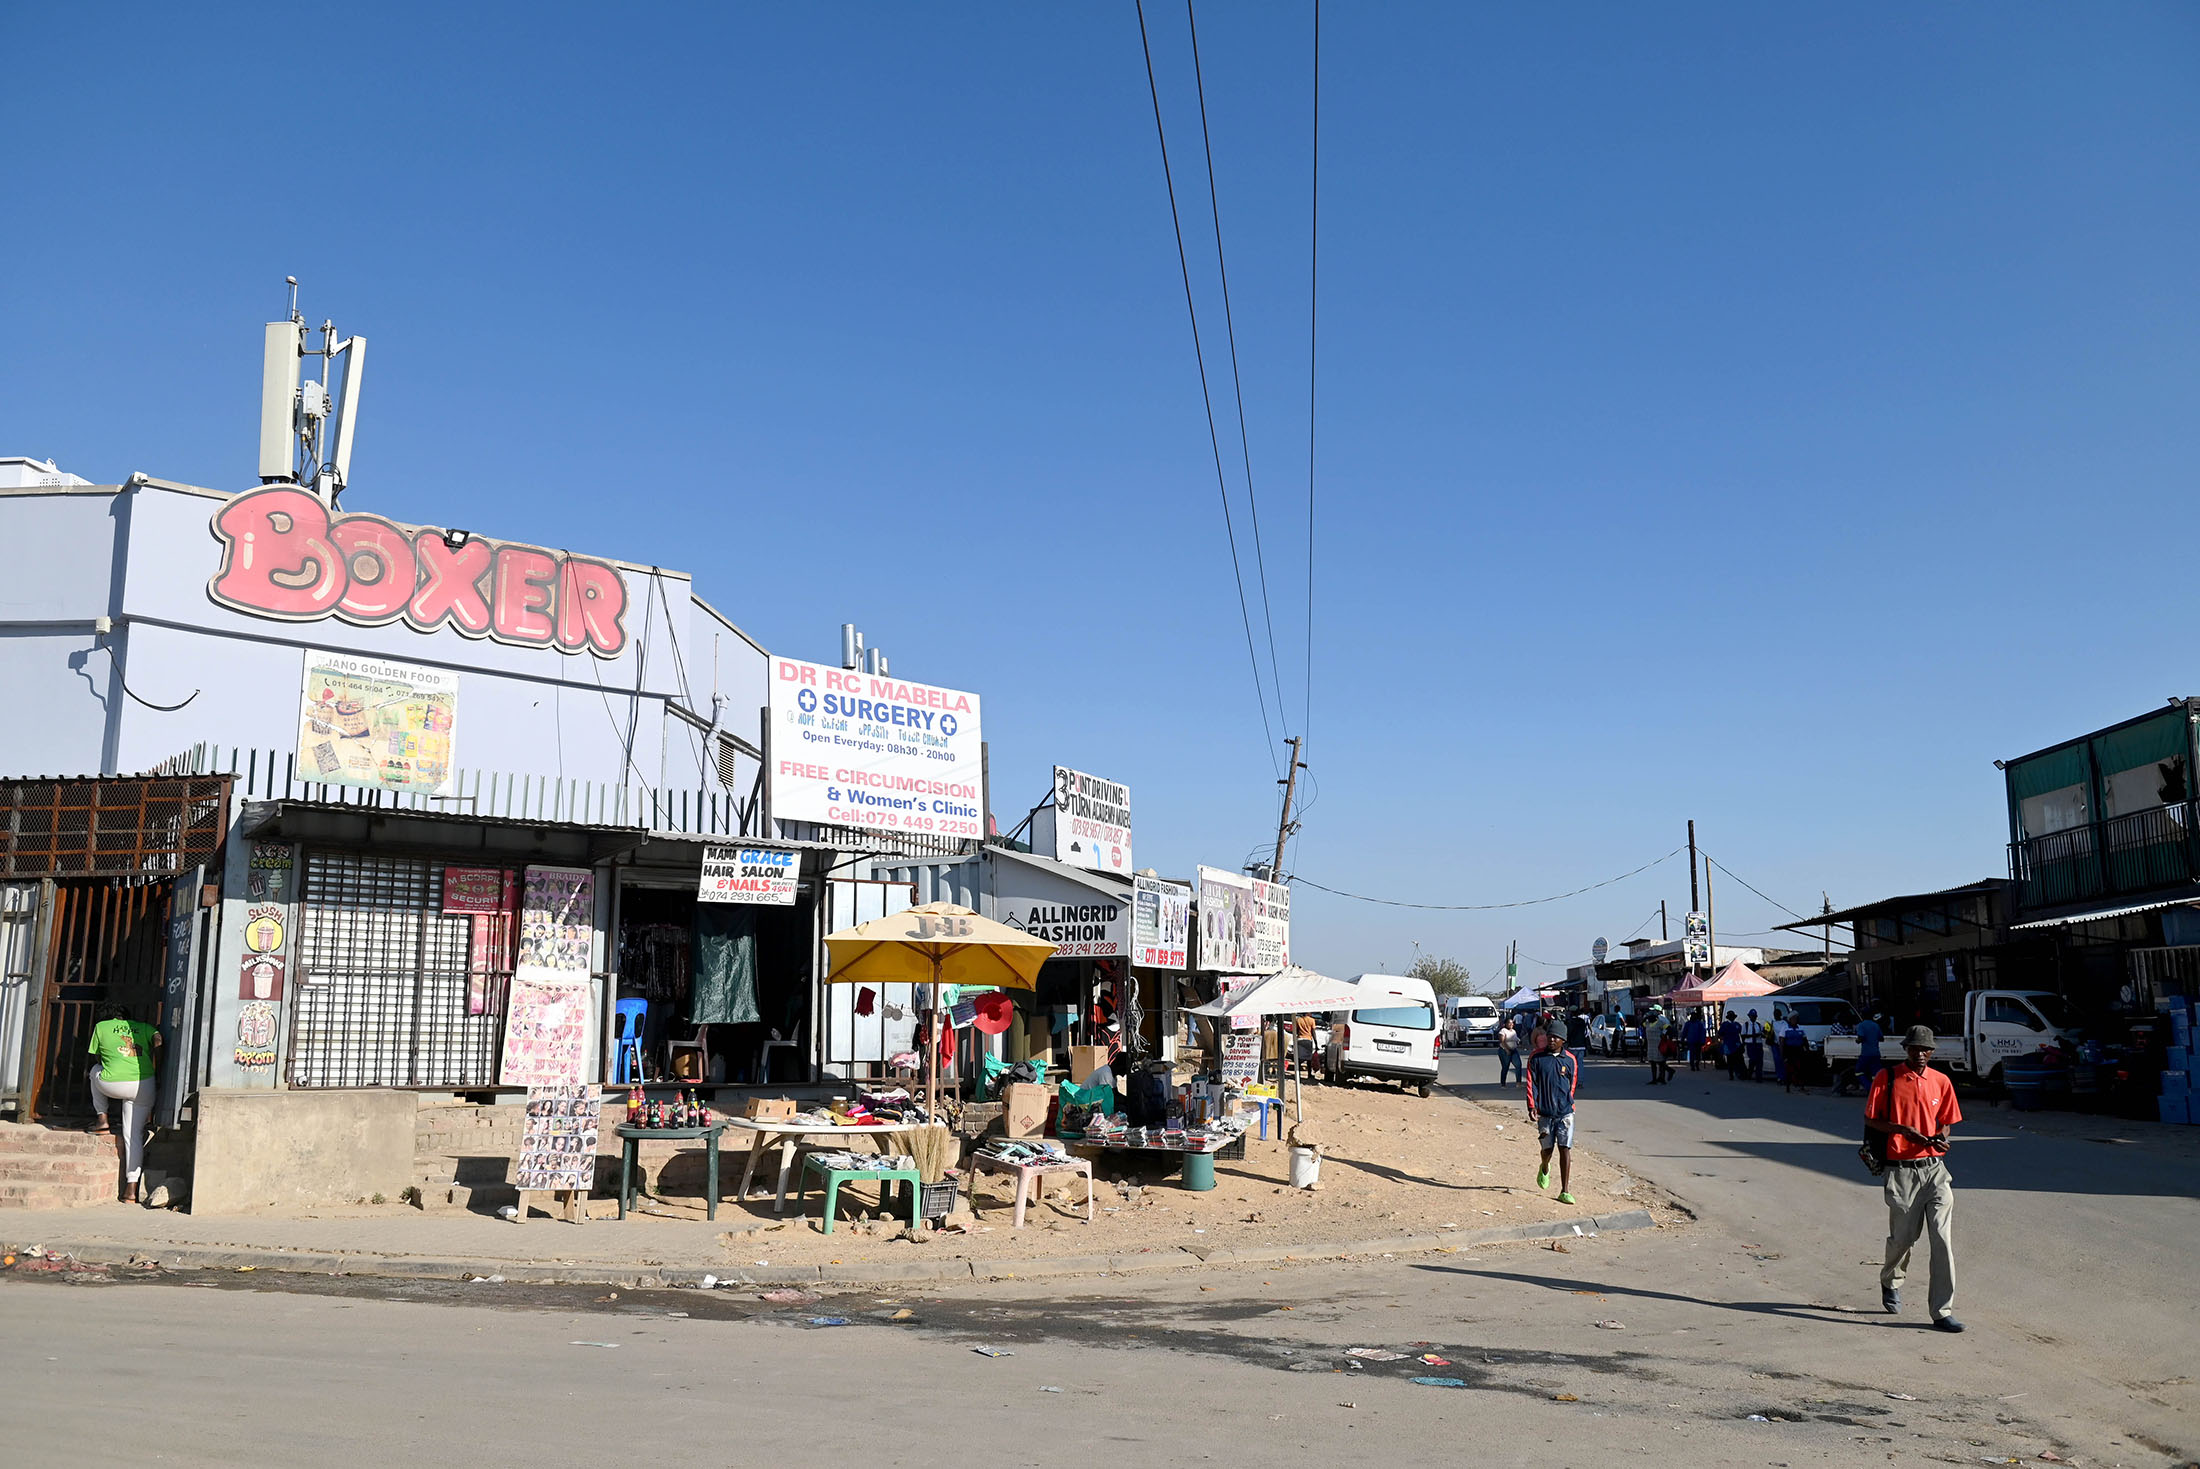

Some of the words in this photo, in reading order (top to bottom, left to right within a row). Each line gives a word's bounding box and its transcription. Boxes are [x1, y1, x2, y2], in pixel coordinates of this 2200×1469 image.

[212, 487, 629, 654] BOXER
[325, 658, 357, 671] JANO
[361, 664, 407, 680] GOLDEN
[410, 672, 441, 685] FOOD
[365, 685, 384, 693] 504
[779, 661, 817, 686] DR
[826, 670, 862, 694] RC
[870, 678, 972, 714] MABELA
[823, 693, 935, 731] SURGERY
[802, 730, 831, 744] Open
[834, 735, 884, 753] Everyday:
[887, 743, 918, 757] 08h30
[926, 750, 956, 762] 20h00
[780, 760, 829, 781] FREE
[835, 768, 976, 799] CIRCUMCISION
[1055, 769, 1070, 813] 3
[1069, 772, 1092, 797] POINT
[1092, 779, 1123, 806] DRIVING
[827, 786, 841, 802] &
[847, 788, 927, 812] Women's
[932, 799, 978, 818] Clinic
[1070, 793, 1092, 819] TURN
[828, 806, 898, 827] Cell:079
[903, 815, 934, 831] 449
[938, 819, 978, 835] 2250
[707, 848, 737, 861] MAMA
[740, 849, 794, 867] GRACE
[549, 871, 585, 880] BRAIDS
[703, 864, 734, 878] HAIR
[740, 866, 785, 878] SALON
[447, 876, 458, 886] M
[729, 879, 771, 892] NAILS
[451, 892, 507, 905] SECURITY
[730, 891, 753, 901] 2931
[1028, 904, 1118, 924] ALLINGRID
[1027, 925, 1106, 942] FASHION
[1055, 943, 1074, 956] 083
[1075, 943, 1091, 955] 241
[1093, 942, 1118, 955] 2228
[1145, 948, 1156, 965] 071
[1225, 1035, 1236, 1048] 3
